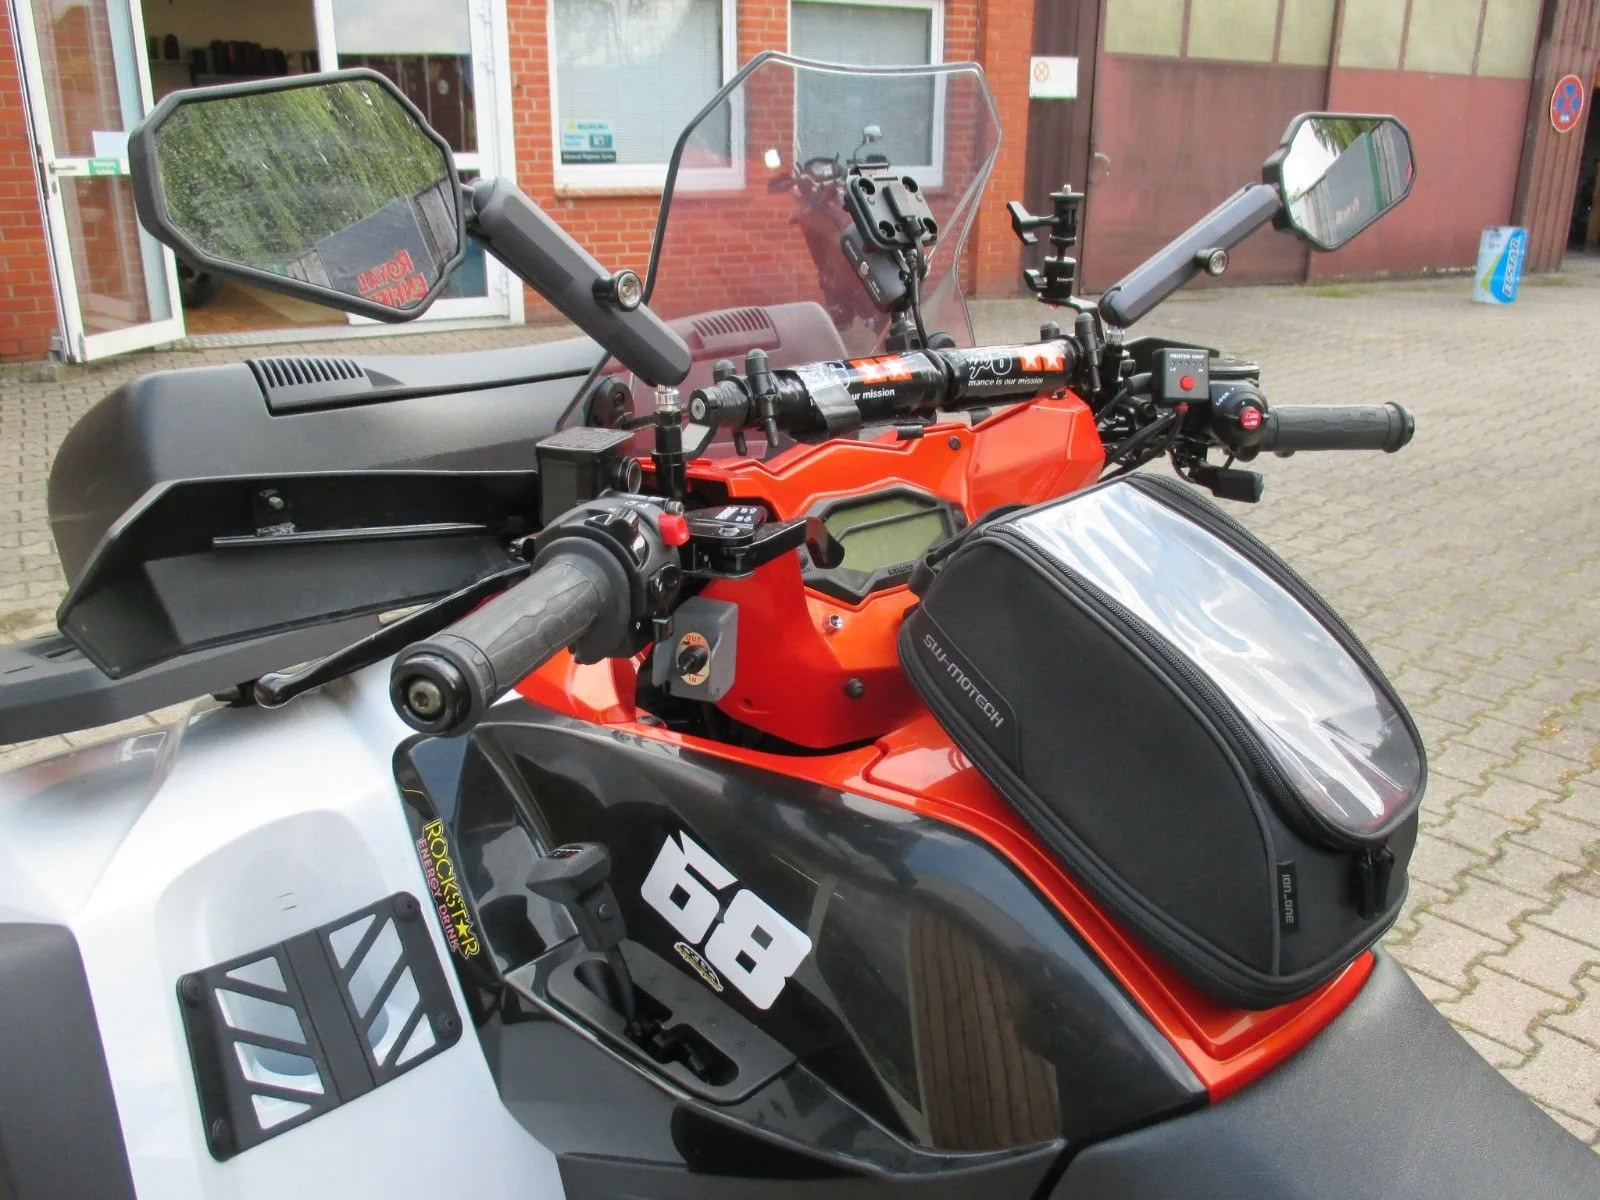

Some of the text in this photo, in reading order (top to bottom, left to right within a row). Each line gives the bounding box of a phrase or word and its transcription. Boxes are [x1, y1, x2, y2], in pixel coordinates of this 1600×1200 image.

[862, 388, 895, 399] mission
[996, 377, 1003, 385] is
[922, 633, 1005, 728] SW-MOTECH
[418, 838, 460, 952] ENERGY DRINK
[640, 830, 813, 1010] 68
